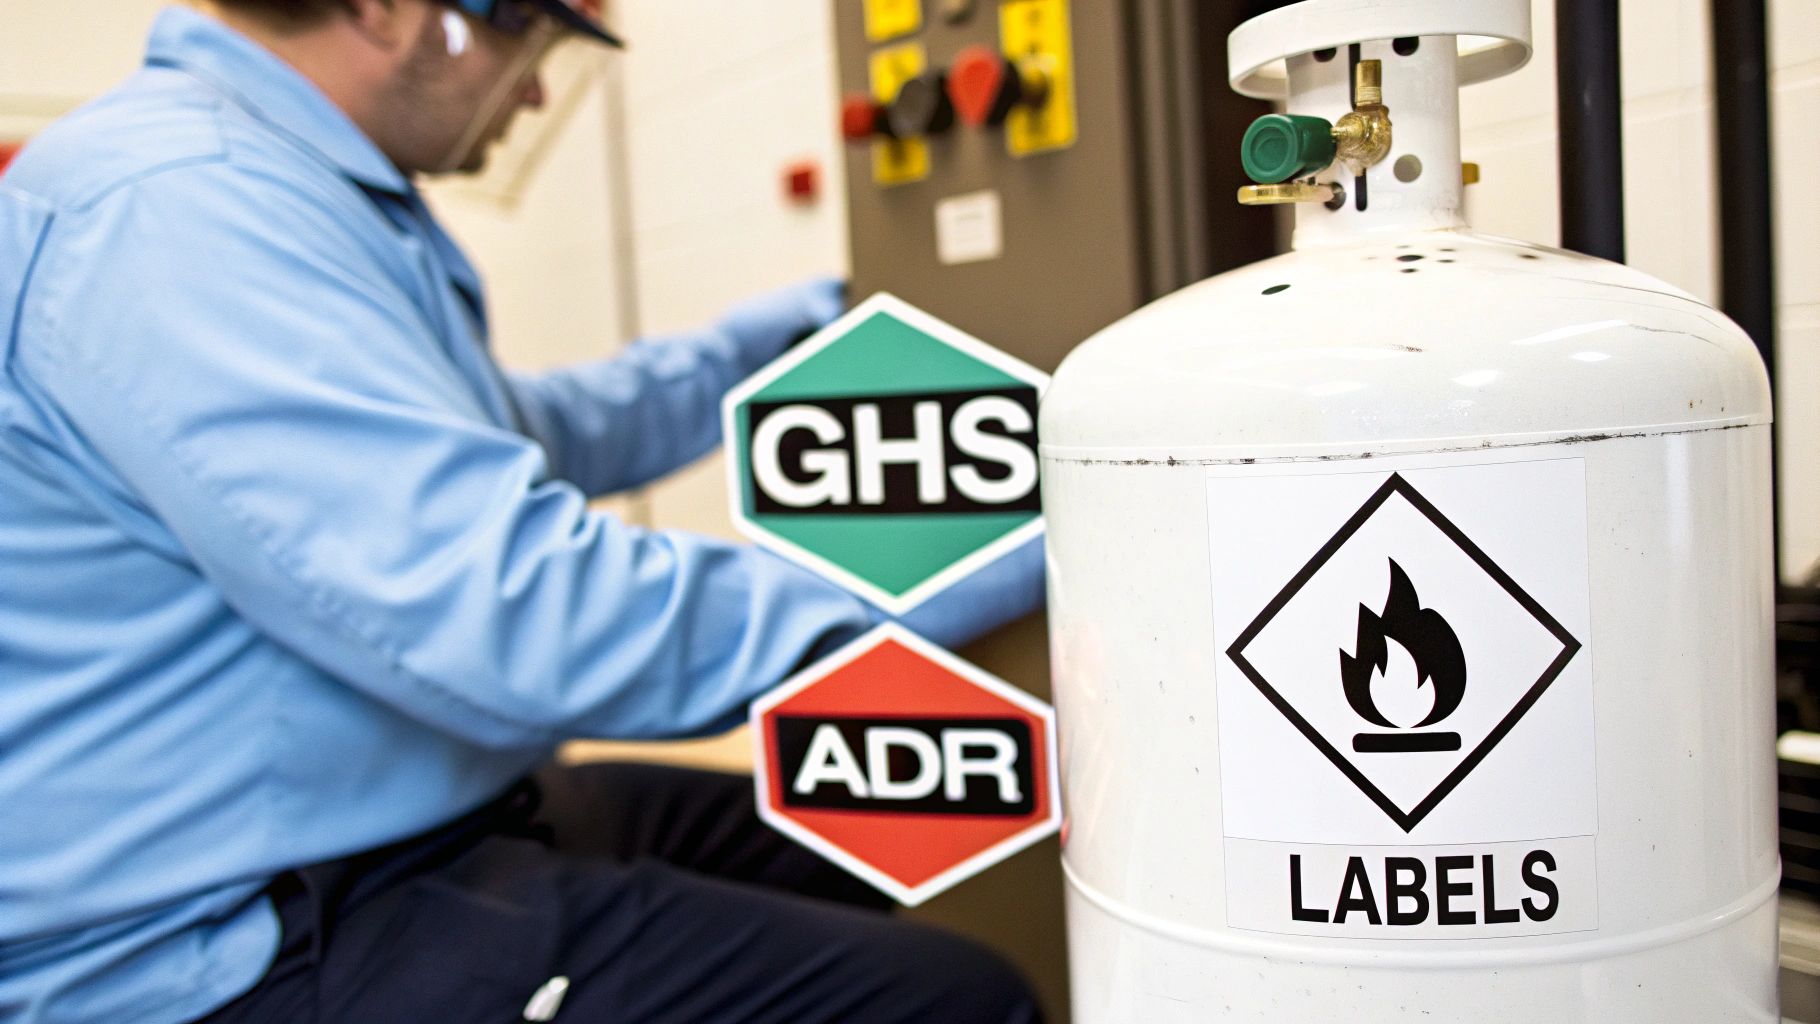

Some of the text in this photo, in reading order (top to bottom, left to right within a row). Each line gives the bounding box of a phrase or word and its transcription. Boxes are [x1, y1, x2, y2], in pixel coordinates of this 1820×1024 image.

[752, 396, 1039, 506] GHS
[793, 724, 1022, 802] ADR
[1290, 850, 1559, 926] LABELS
